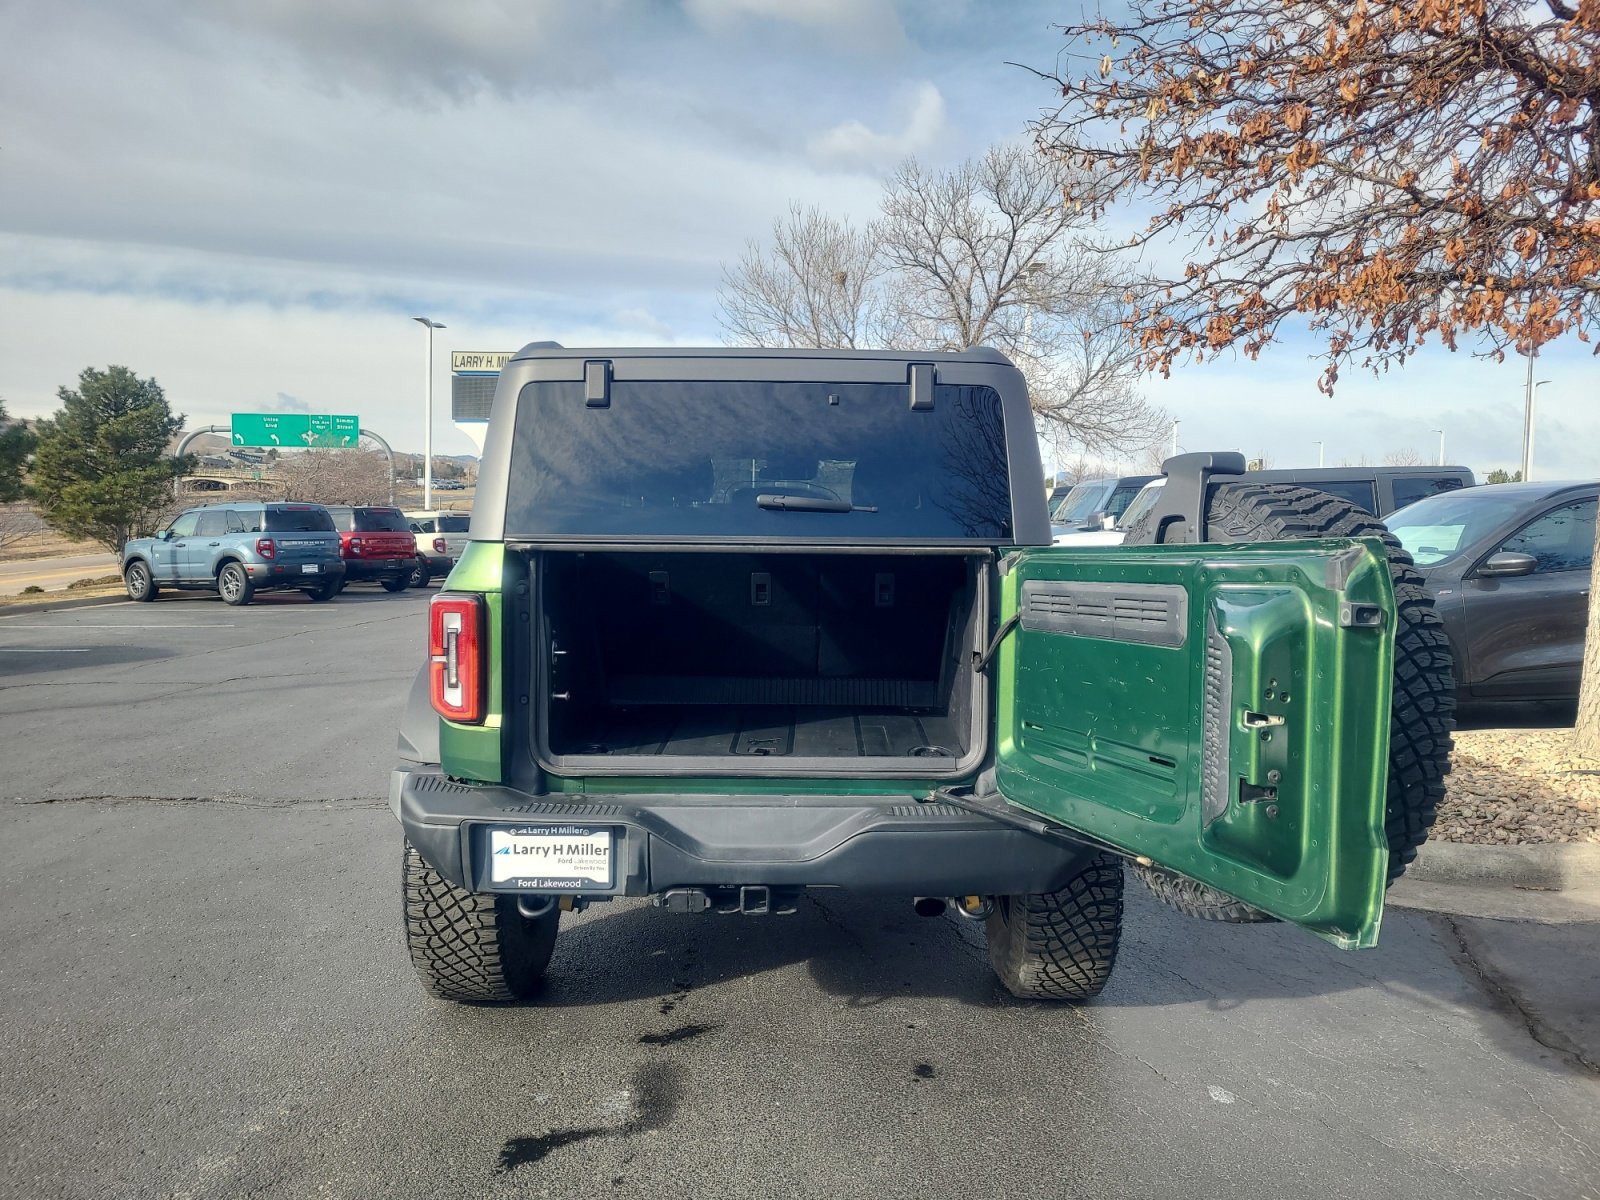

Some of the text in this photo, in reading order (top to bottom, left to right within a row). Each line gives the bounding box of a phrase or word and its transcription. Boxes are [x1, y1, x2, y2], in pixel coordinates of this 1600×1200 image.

[454, 355, 485, 368] LARRY
[486, 355, 495, 368] H.
[528, 827, 550, 835] Larry
[559, 826, 583, 834] Miller
[513, 843, 609, 858] Larry H Miller
[517, 878, 582, 888] Ford Lakewood
